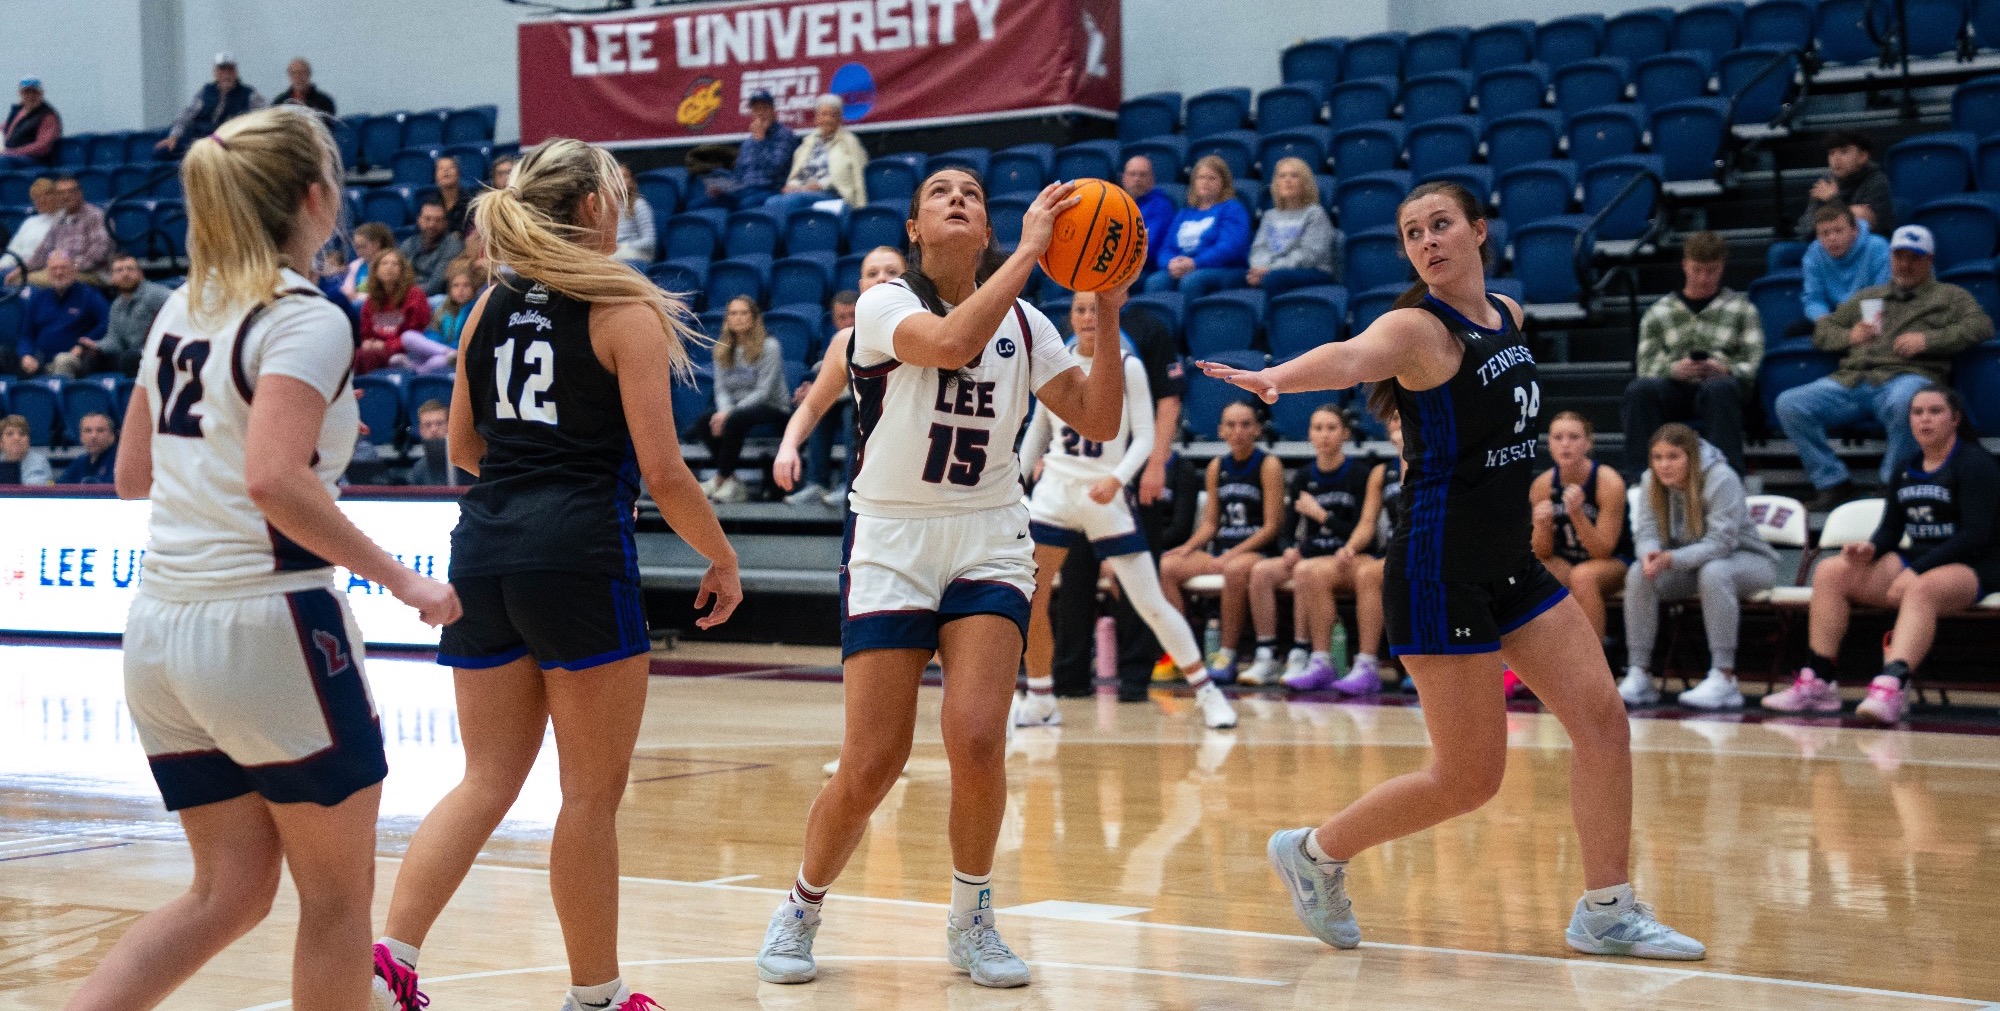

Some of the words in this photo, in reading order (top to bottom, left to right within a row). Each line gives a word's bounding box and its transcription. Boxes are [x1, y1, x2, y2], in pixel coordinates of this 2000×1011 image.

[569, 23, 659, 76] LEE
[674, 0, 1000, 68] UNIVERSITY
[1091, 217, 1124, 274] NCAA
[508, 309, 553, 332] Bulldogs
[998, 341, 1014, 354] LC
[156, 332, 212, 438] 12
[494, 337, 558, 426] 12
[935, 369, 996, 419] LEE
[1513, 380, 1540, 434] 34
[922, 421, 990, 487] 15
[40, 547, 98, 587] LEE
